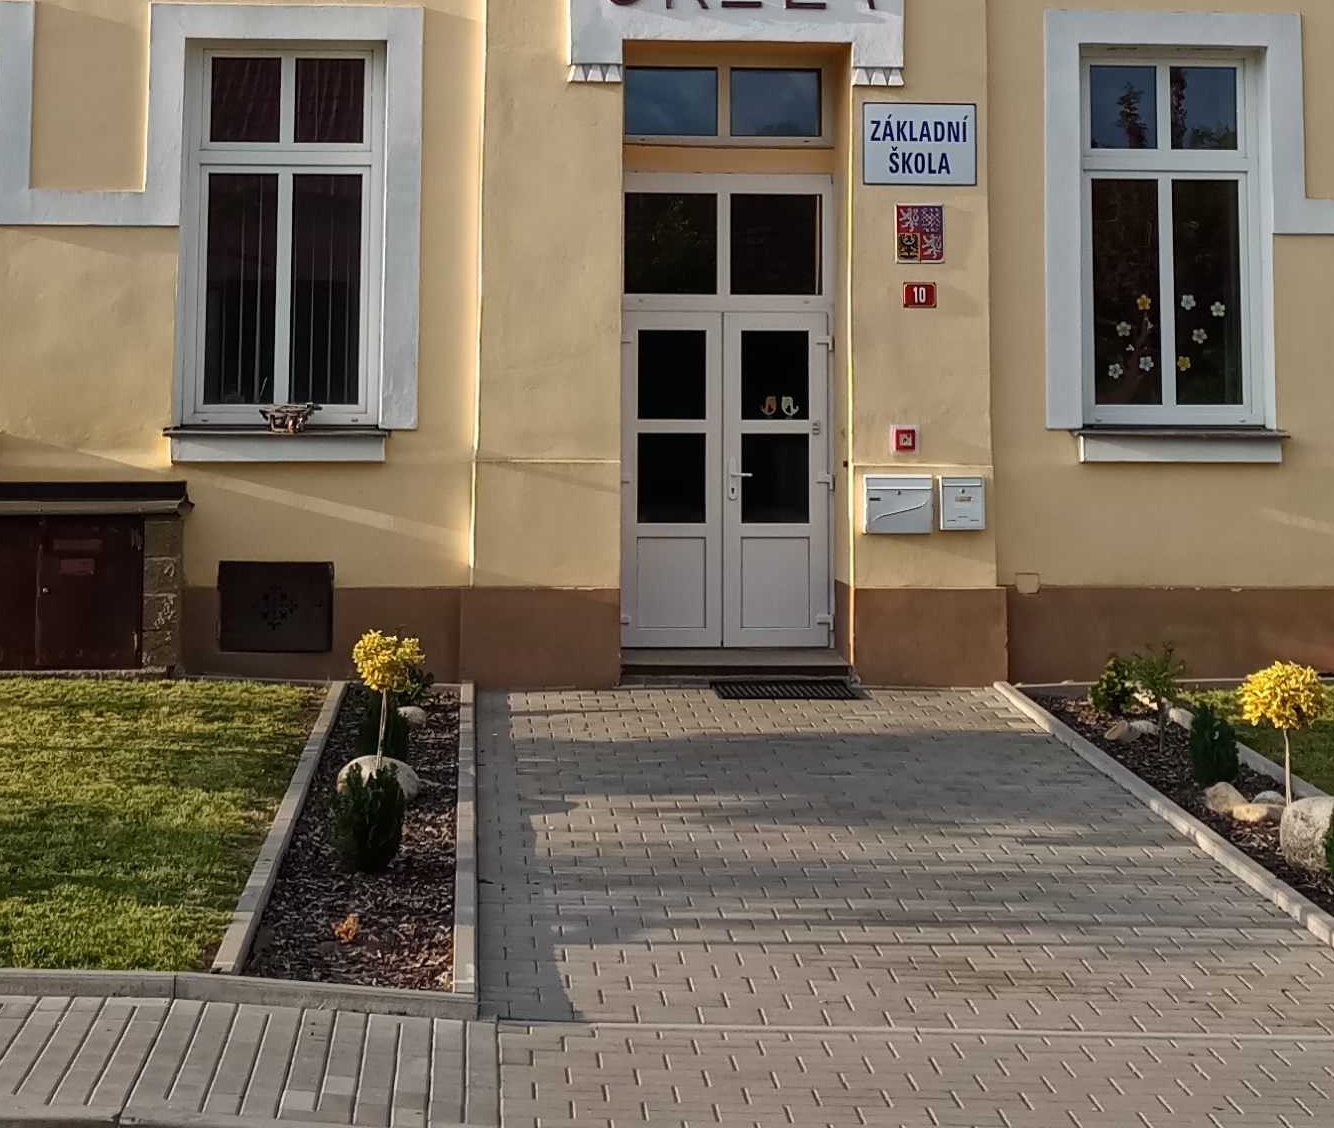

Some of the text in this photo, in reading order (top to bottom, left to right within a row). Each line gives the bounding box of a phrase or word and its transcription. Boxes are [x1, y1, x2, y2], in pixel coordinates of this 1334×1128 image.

[870, 114, 968, 143] ZÁKLADNÍ
[889, 146, 951, 174] ŠKOLA
[913, 286, 926, 303] 10
